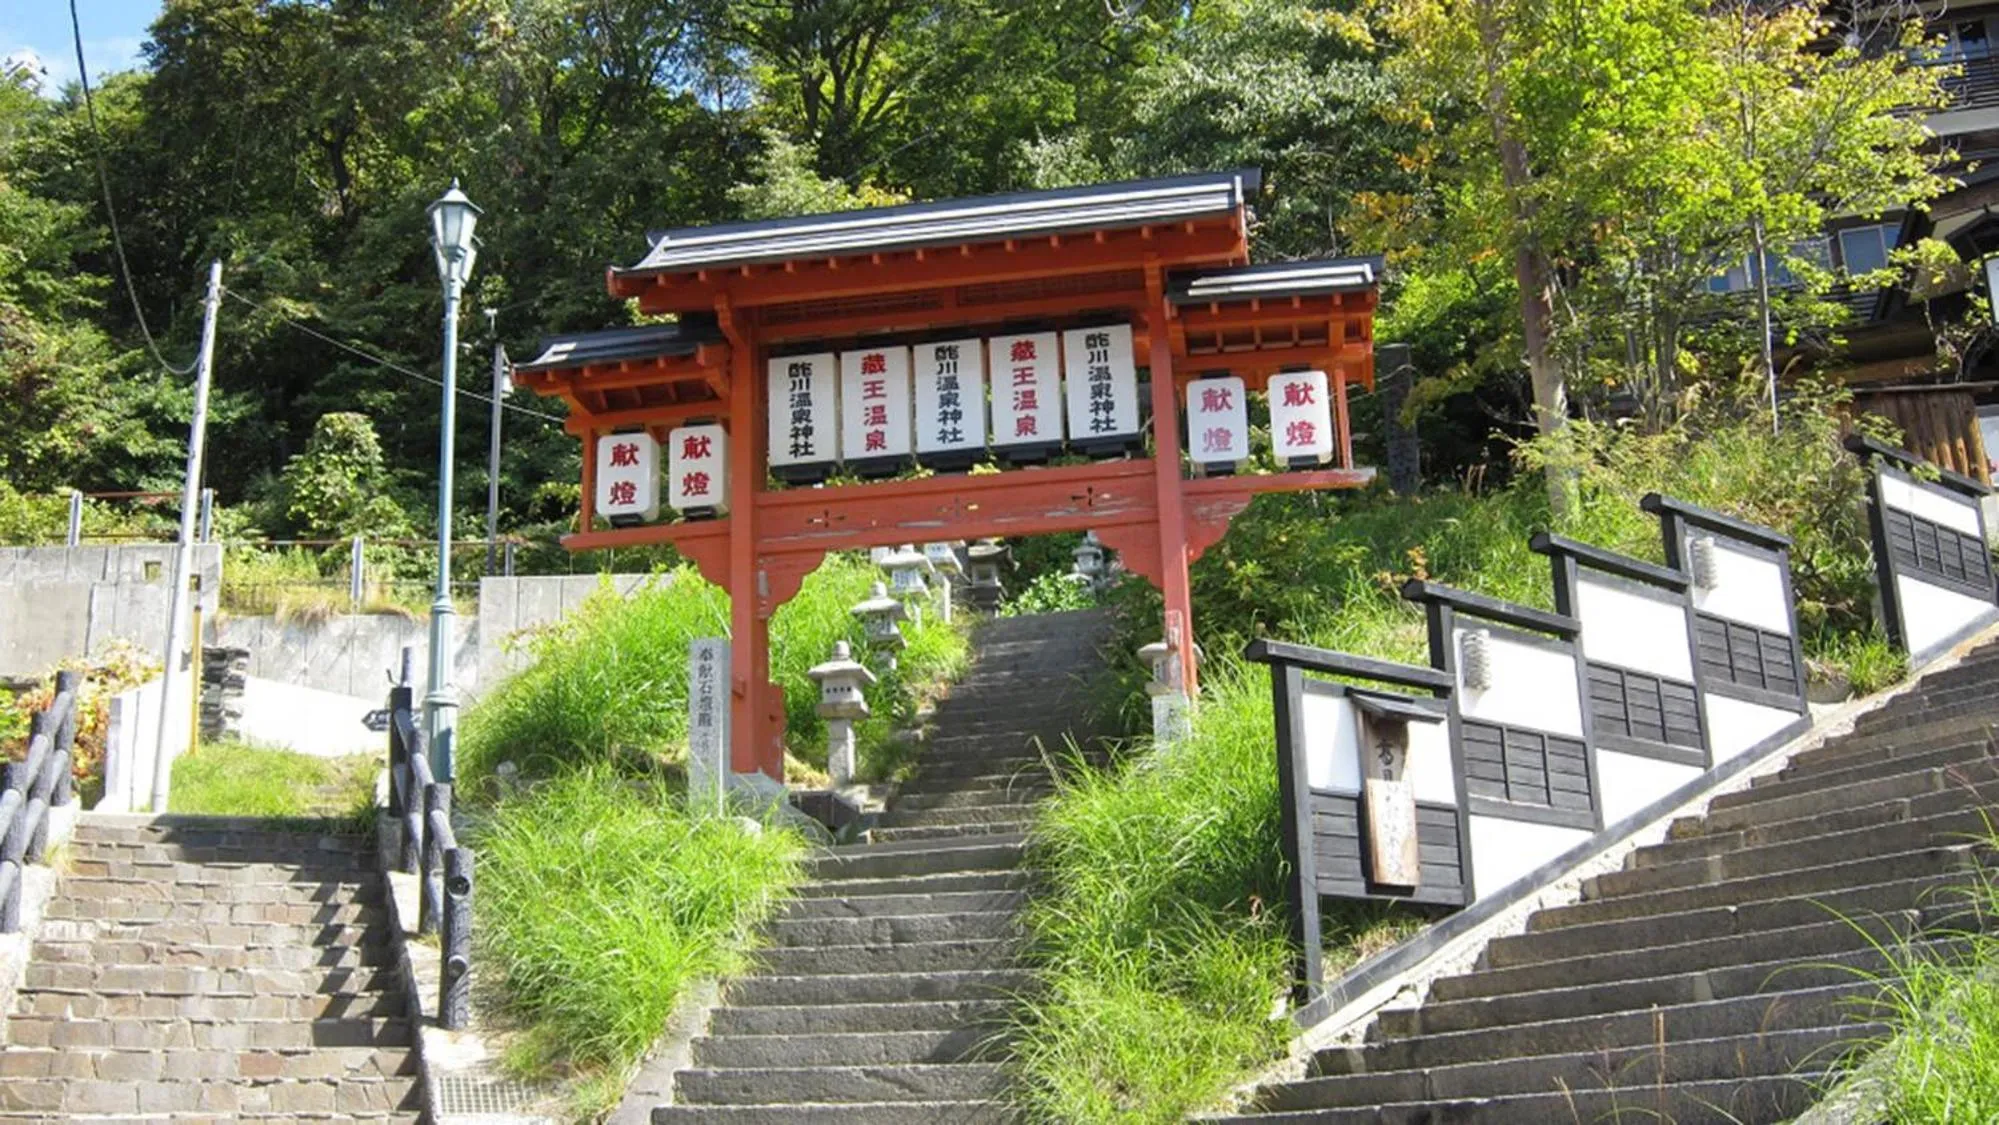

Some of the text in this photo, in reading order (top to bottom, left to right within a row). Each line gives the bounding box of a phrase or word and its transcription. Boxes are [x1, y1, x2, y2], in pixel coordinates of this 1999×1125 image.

[861, 353, 888, 451] 蔵王温泉
[1010, 340, 1039, 437] 蔵王温泉
[1200, 388, 1234, 453] 献燈
[1282, 382, 1316, 447] 献燈
[609, 442, 639, 506] 献燈
[681, 435, 711, 496] 献燈
